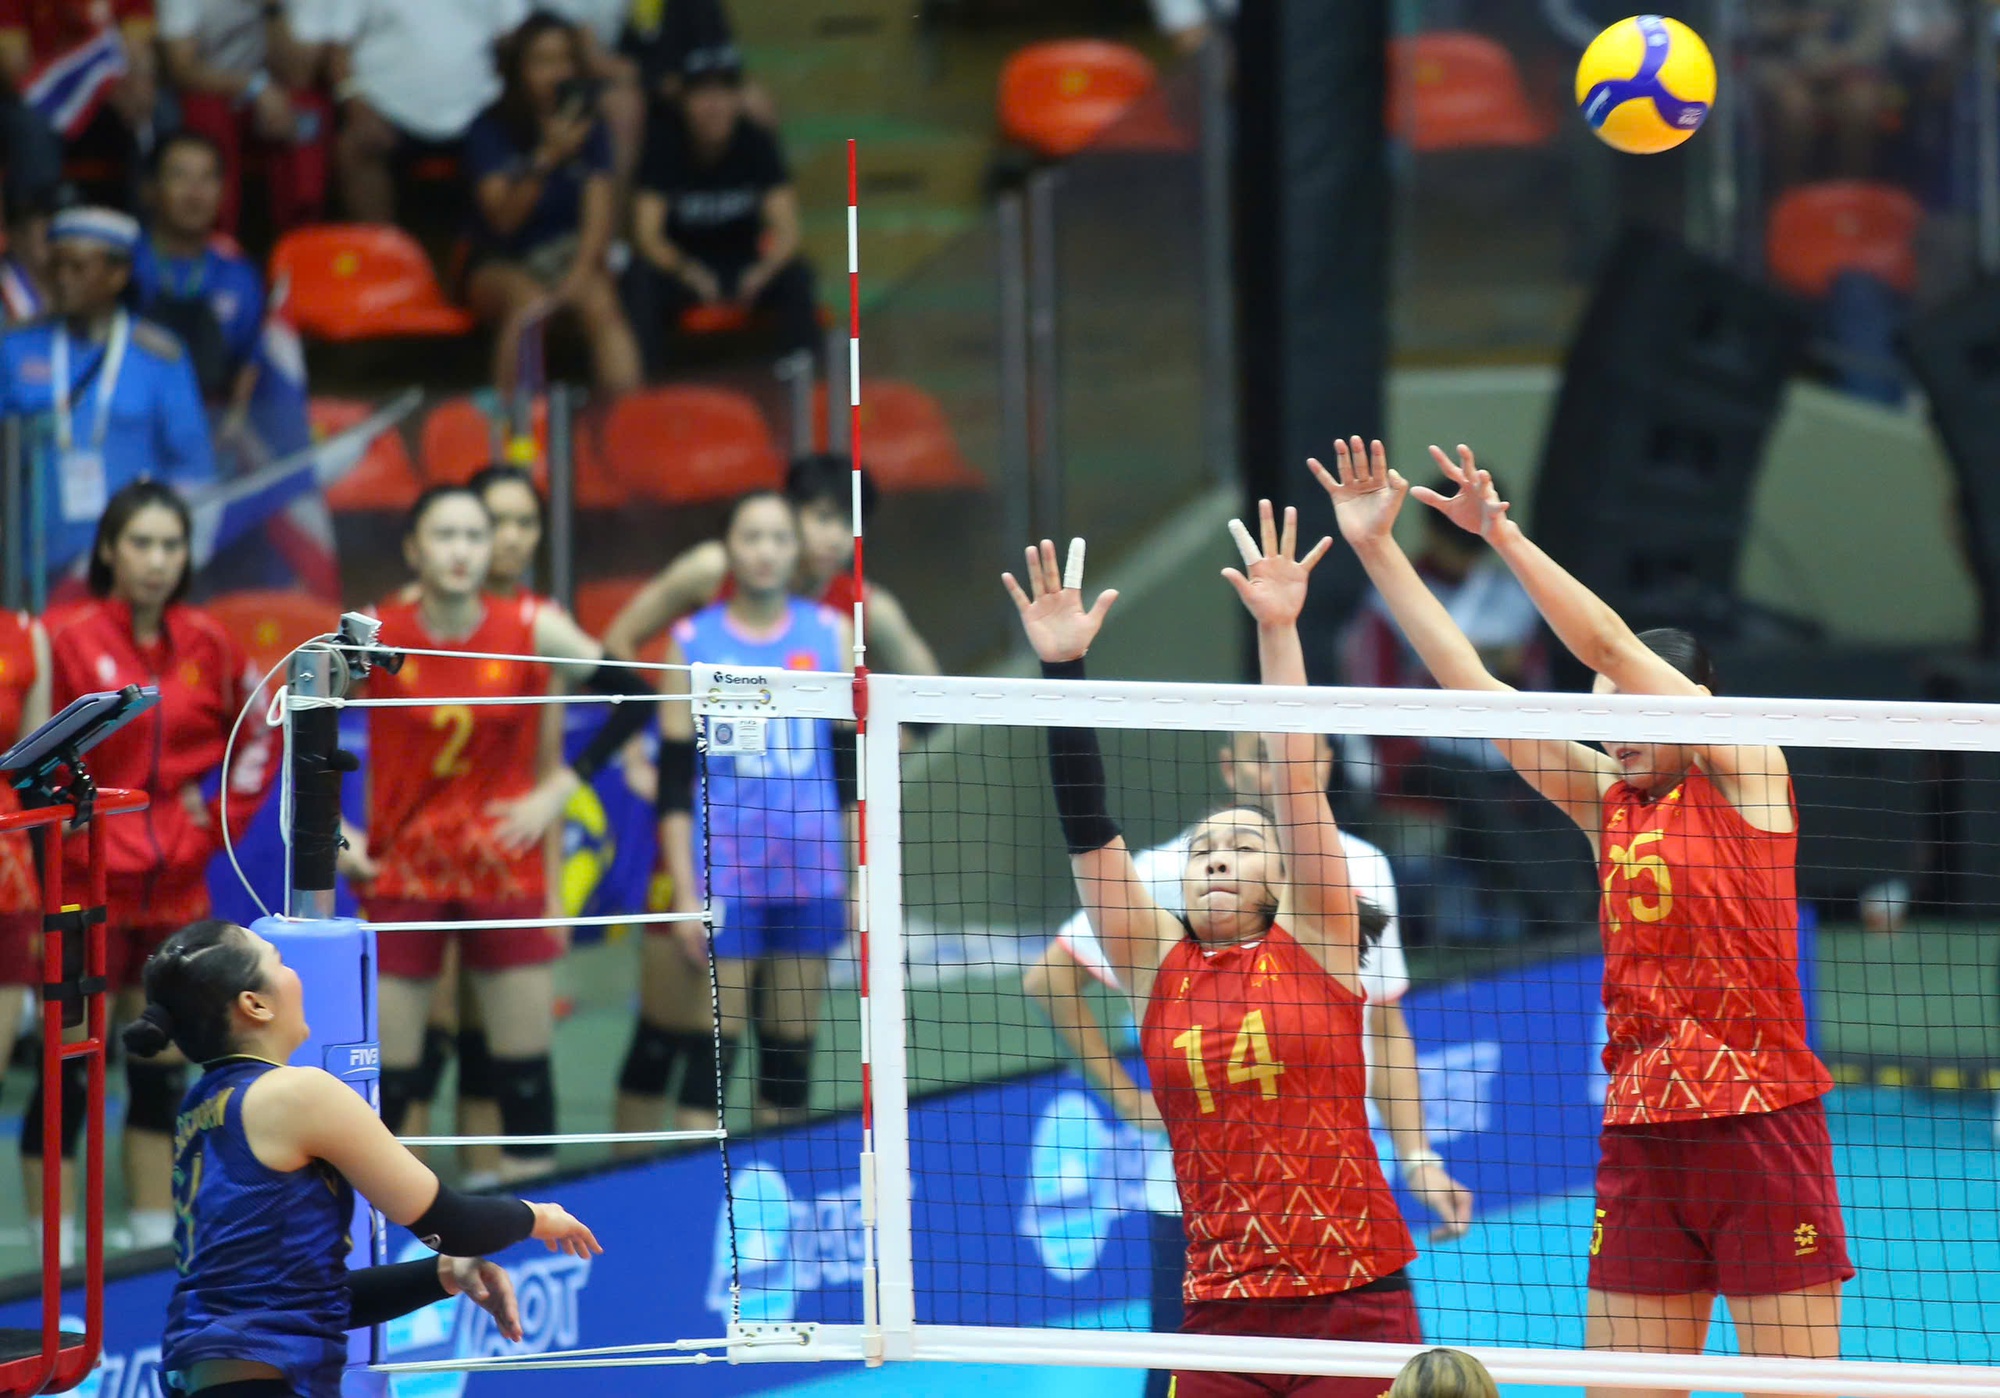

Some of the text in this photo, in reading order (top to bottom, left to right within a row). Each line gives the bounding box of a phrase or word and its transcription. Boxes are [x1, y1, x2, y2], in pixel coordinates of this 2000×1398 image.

[725, 673, 767, 685] Senoh
[432, 704, 474, 778] 2
[1173, 1009, 1285, 1114] 14
